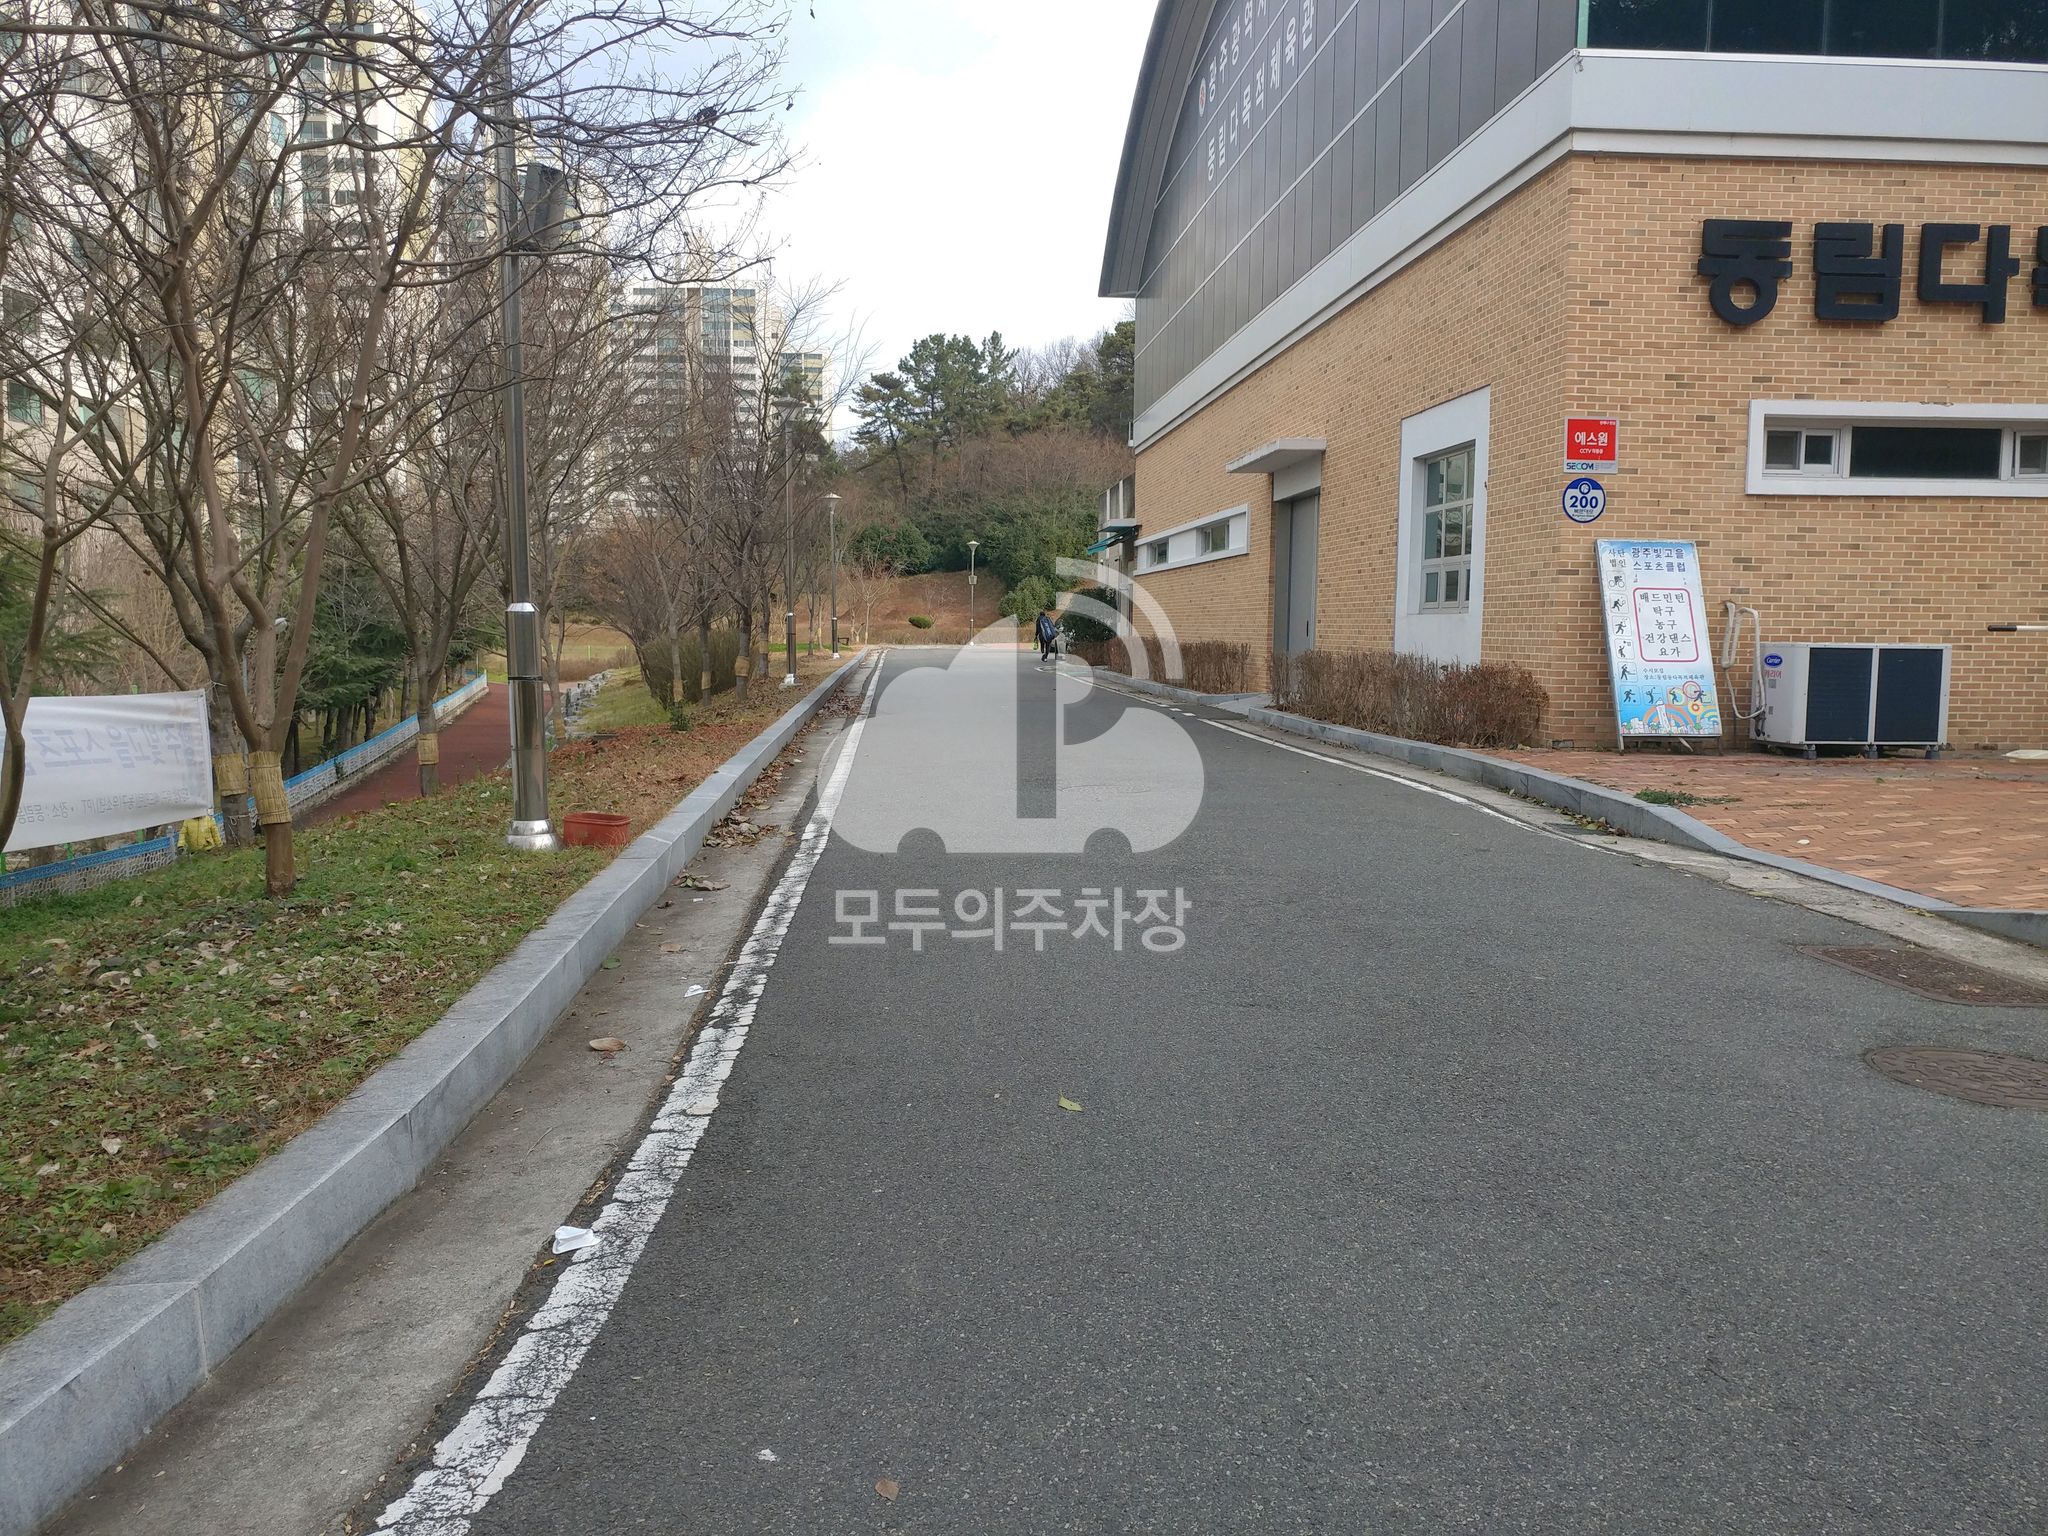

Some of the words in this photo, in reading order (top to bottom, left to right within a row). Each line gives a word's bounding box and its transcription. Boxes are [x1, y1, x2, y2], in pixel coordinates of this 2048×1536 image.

[1207, 0, 1314, 182] 동림다목적체육관
[1697, 218, 2048, 327] 동림다
[1574, 431, 1609, 446] 에스원
[1566, 462, 1594, 471] SECOM
[1569, 495, 1599, 509] 200
[1631, 547, 1685, 559] 광주빛고을
[1633, 561, 1686, 573] 스포츠클럽
[1639, 592, 1686, 604] 배드민턴
[1653, 606, 1675, 616] 탁구
[1654, 619, 1678, 630] 농구
[1644, 632, 1692, 645] 건강댄스
[1658, 646, 1681, 657] 요가
